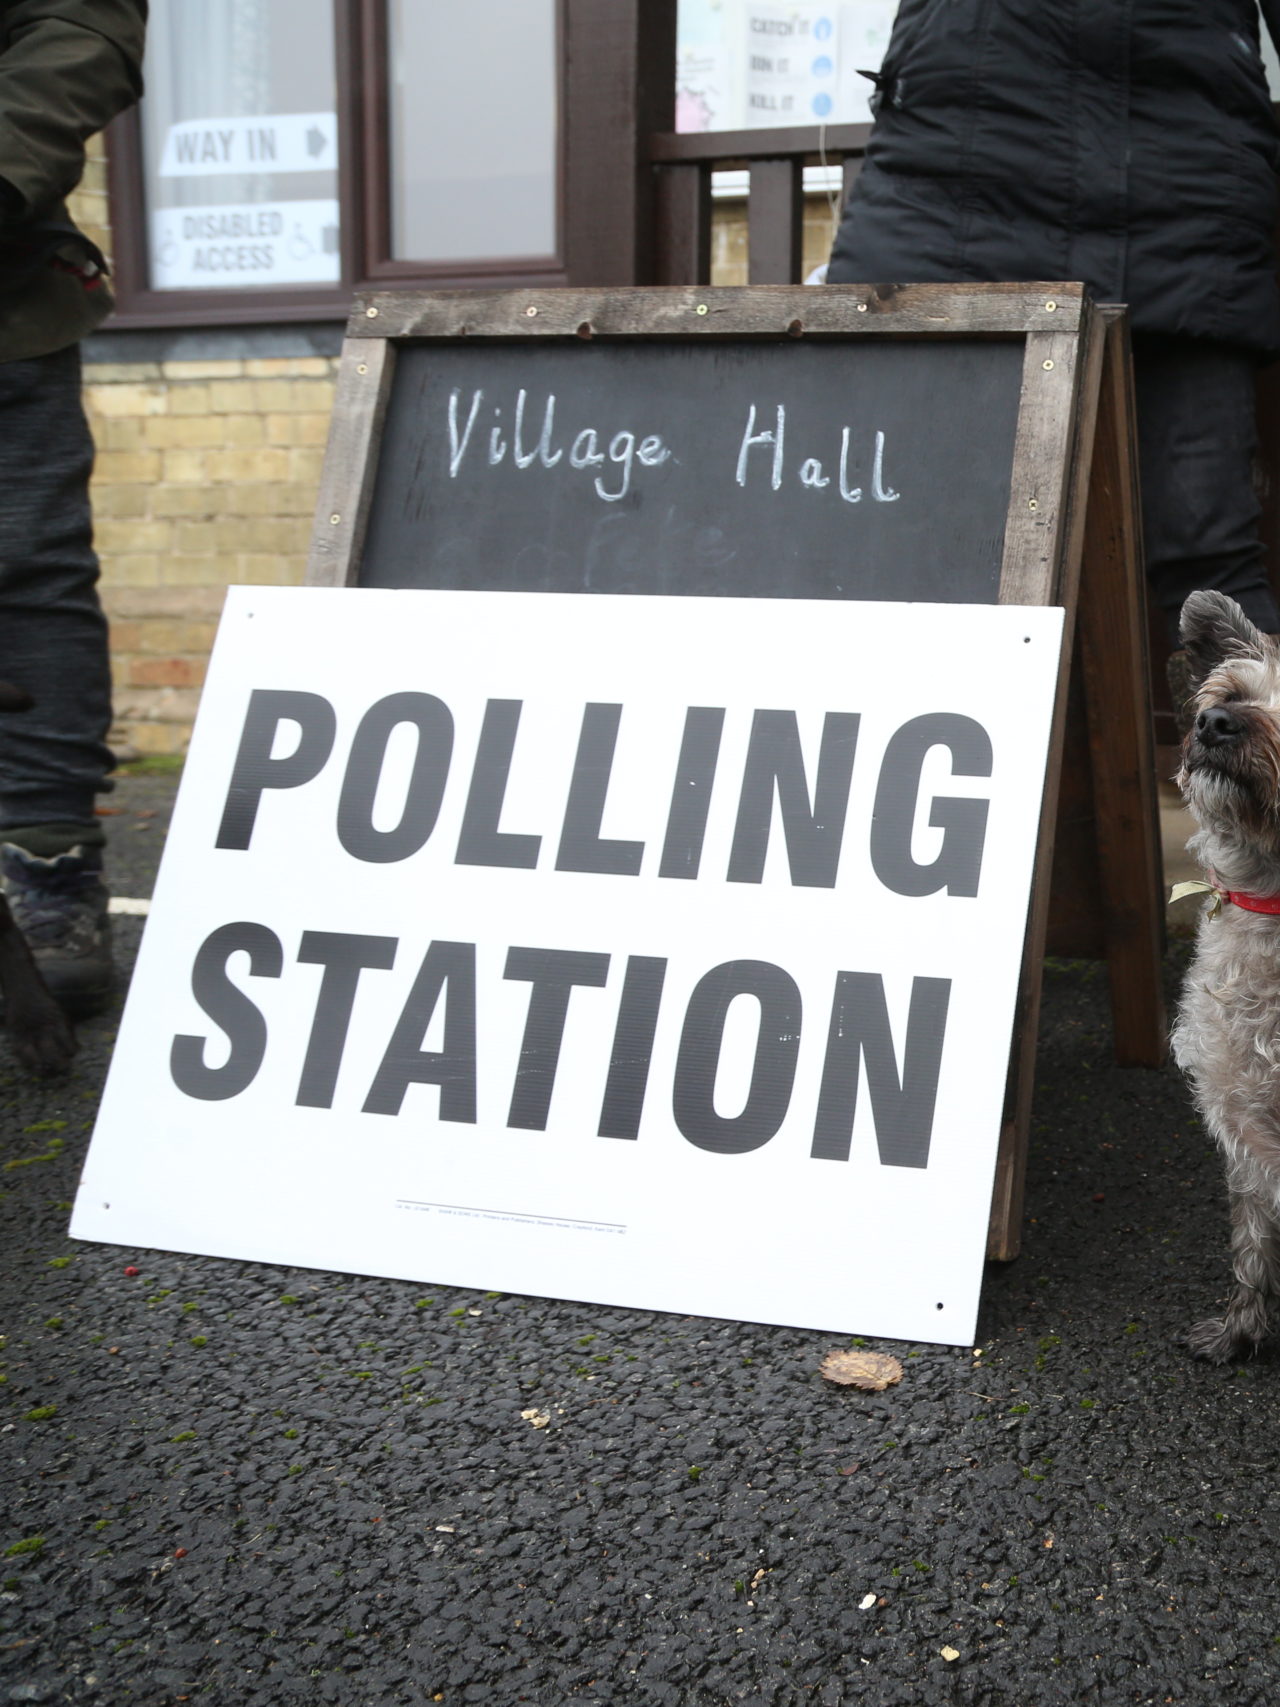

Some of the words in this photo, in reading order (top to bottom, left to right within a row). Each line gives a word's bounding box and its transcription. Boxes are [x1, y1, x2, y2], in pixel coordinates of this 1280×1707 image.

[751, 18, 793, 36] CATCH
[798, 19, 811, 35] IT
[750, 55, 773, 73] BIN
[777, 57, 790, 73] IT
[749, 93, 777, 110] KILL
[781, 95, 795, 110] IT
[175, 130, 234, 163] WAY
[248, 128, 277, 161] IN
[183, 212, 282, 239] DISABLED
[194, 245, 273, 271] ACCESS
[447, 387, 672, 501] Village
[735, 403, 901, 503] Hall
[214, 688, 994, 899] POLLING
[168, 921, 953, 1170] STATION
